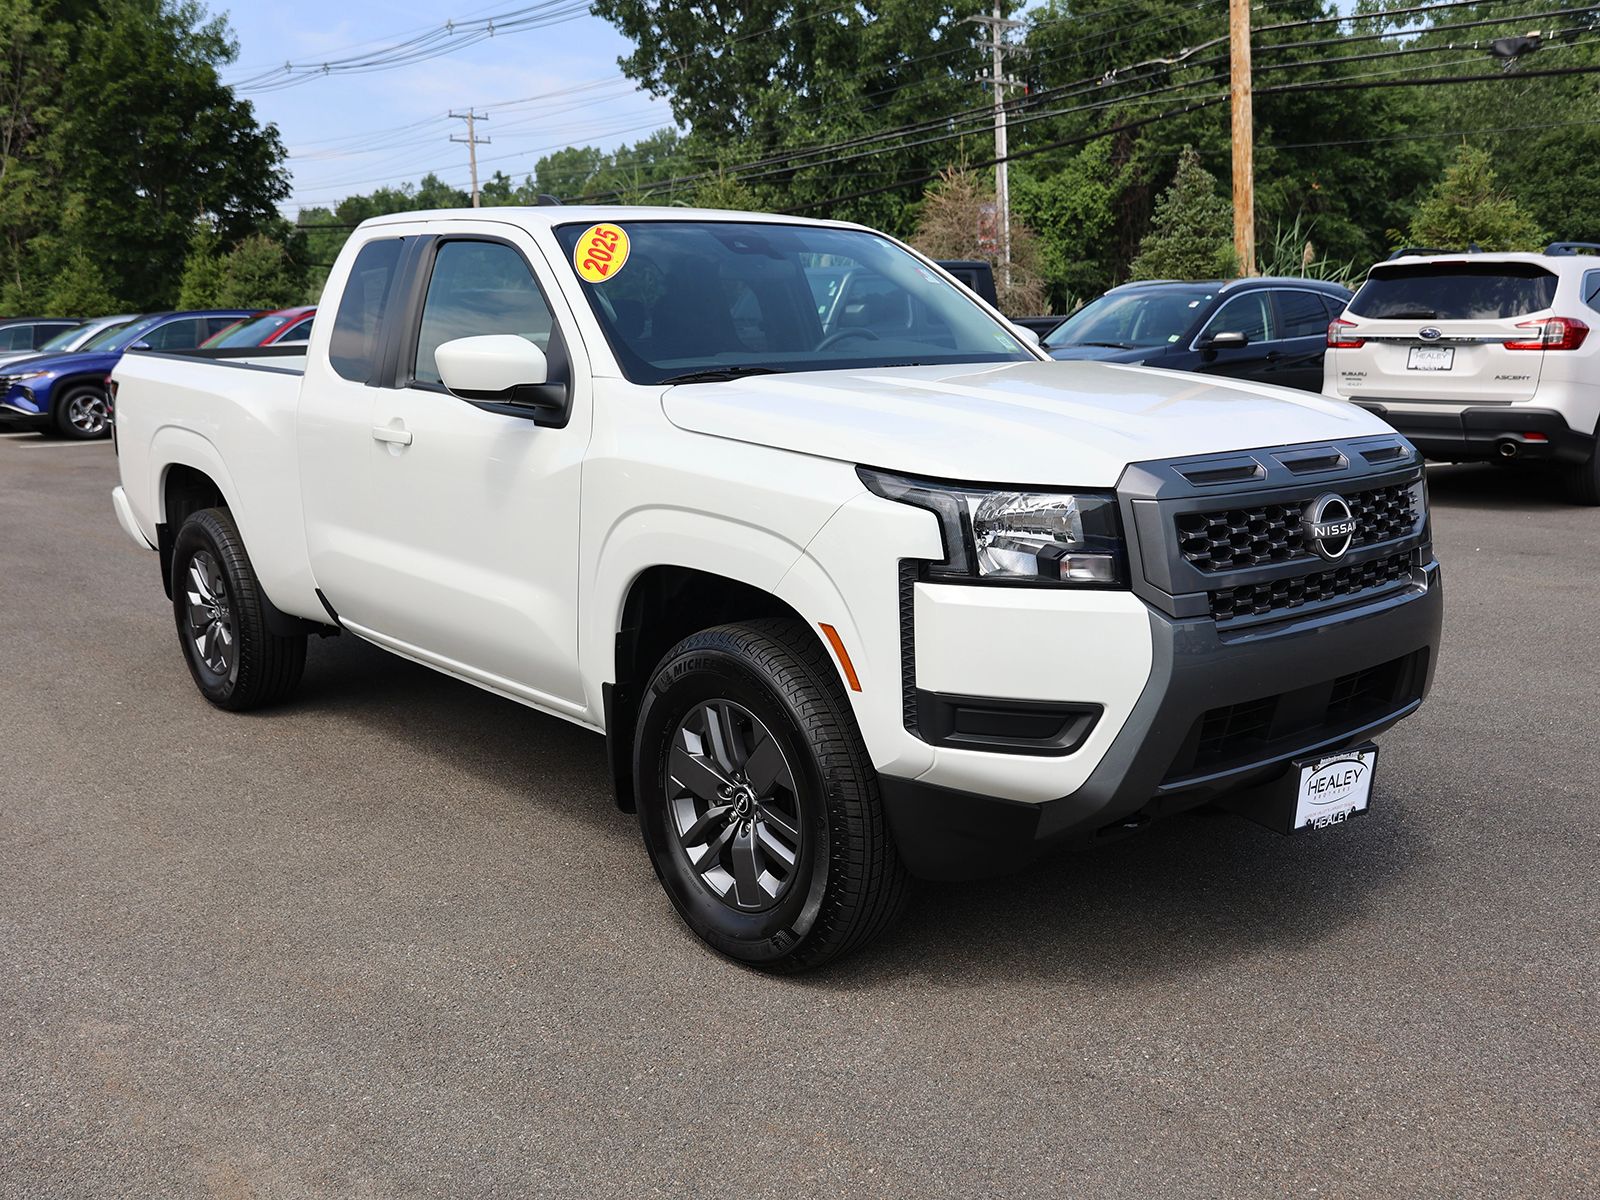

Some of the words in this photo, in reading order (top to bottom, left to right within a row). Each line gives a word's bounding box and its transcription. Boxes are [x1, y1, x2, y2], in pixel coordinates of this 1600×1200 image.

[583, 228, 619, 276] 2025
[1314, 521, 1356, 537] NISSAN
[1308, 768, 1363, 796] HEALEY
[1313, 810, 1351, 830] HEALEY
